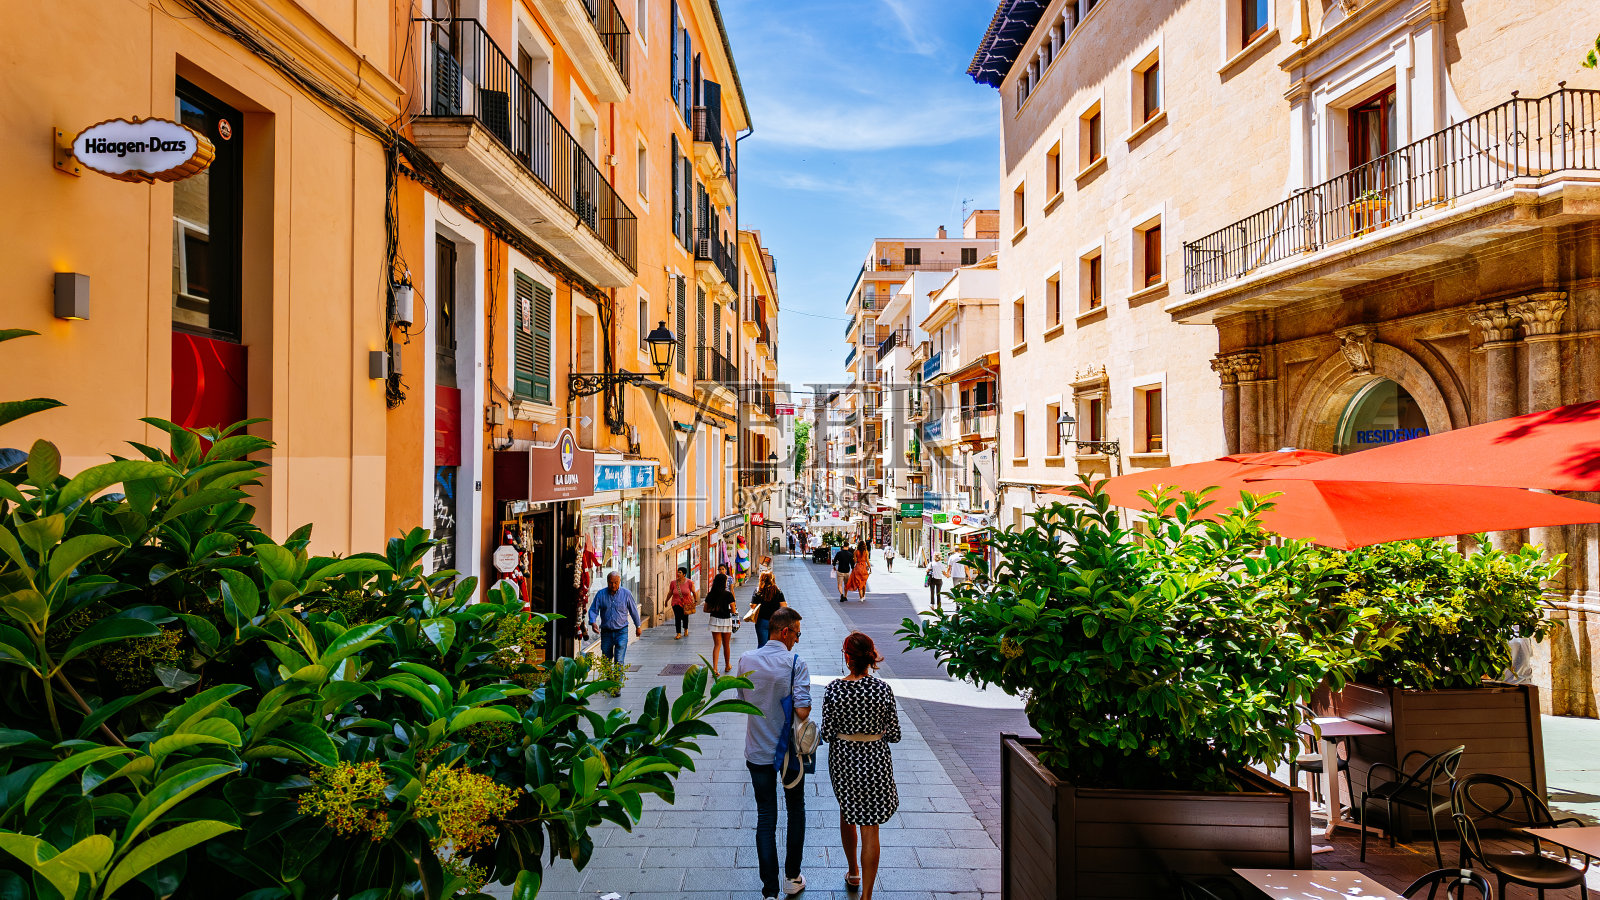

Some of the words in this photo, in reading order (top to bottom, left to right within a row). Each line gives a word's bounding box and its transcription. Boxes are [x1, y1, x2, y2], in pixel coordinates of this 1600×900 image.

[85, 137, 186, 157] Häagen-Dazs
[554, 474, 564, 485] LA
[564, 474, 579, 485] LUNA
[752, 514, 763, 523] illy
